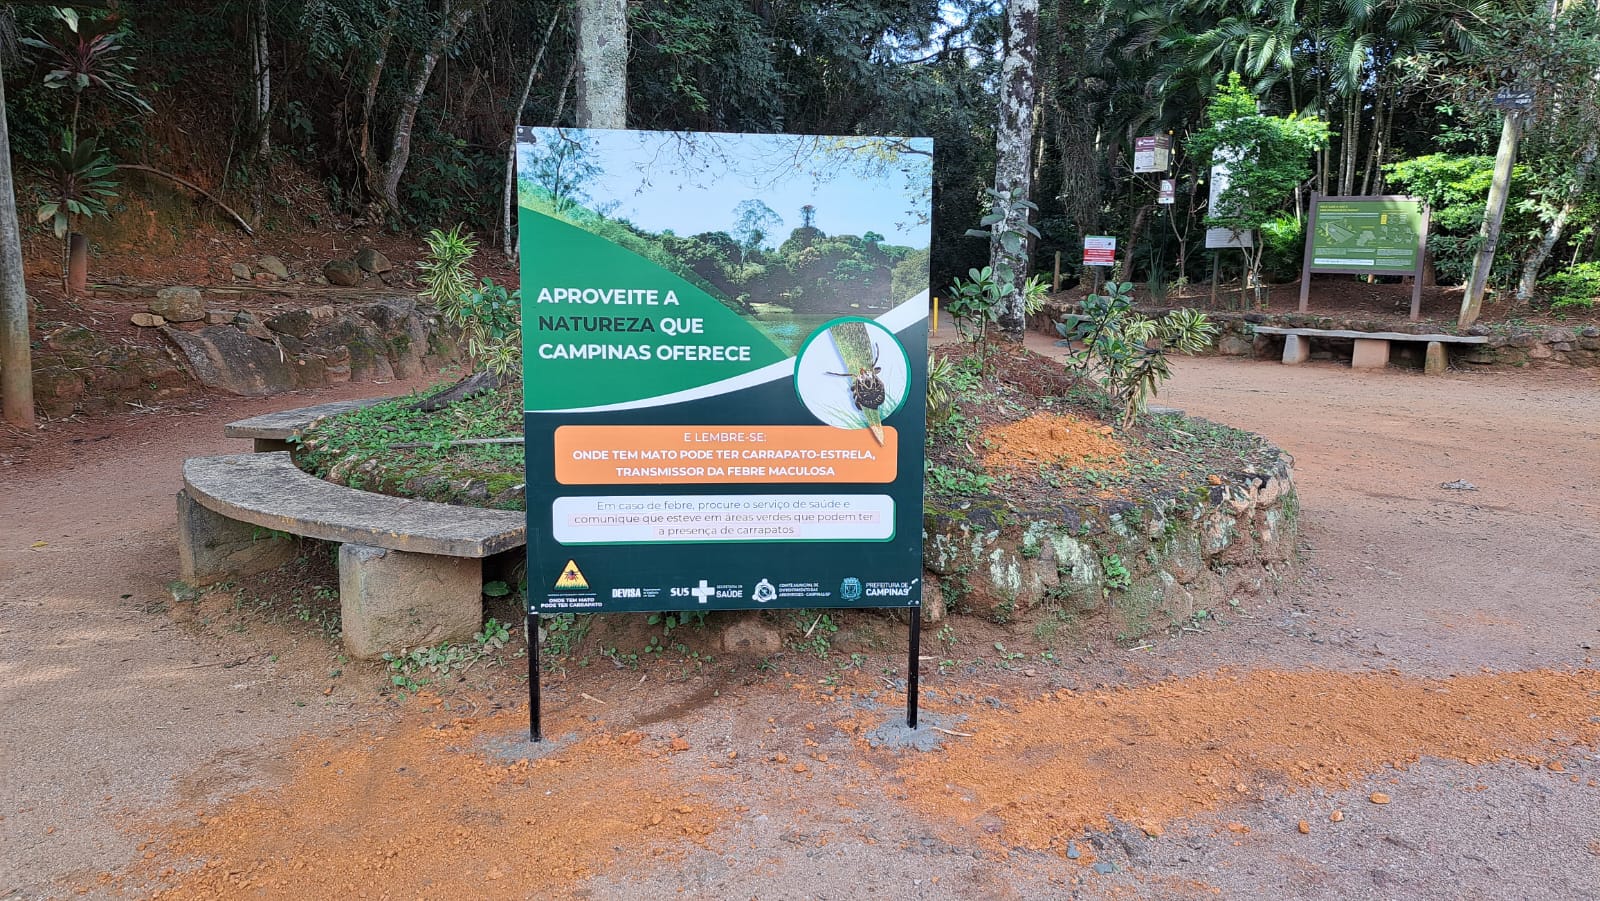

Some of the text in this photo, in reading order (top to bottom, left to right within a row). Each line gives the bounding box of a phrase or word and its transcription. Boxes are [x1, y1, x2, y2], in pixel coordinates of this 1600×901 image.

[537, 288, 680, 306] APROVEITE A
[538, 315, 704, 336] NATUREZA QUE
[538, 343, 751, 361] CAMPINAS OFERECE
[684, 432, 767, 442] E LEMBRE-SE:
[572, 450, 876, 461] ONDE TEM MATO PODE TER CARRAPATO-ESTRELA,
[616, 466, 836, 477] TRANSMISSOR DA FEBRE MACULOSA
[597, 501, 616, 511] Em
[618, 502, 644, 510] caso
[647, 501, 661, 510] de
[664, 500, 695, 511] febre,
[698, 501, 740, 513] procure
[753, 500, 790, 511] serviço
[793, 499, 806, 508] de
[809, 499, 841, 509] saúde
[574, 514, 640, 525] comunique
[642, 515, 664, 525] que
[666, 514, 702, 523] esteve
[725, 513, 754, 522] áreas
[756, 512, 792, 521] verdes
[794, 513, 815, 523] que
[817, 512, 856, 523] podem
[858, 512, 873, 521] ter
[658, 525, 794, 538] a presença de carrapatos
[612, 588, 641, 598] DEVISA
[670, 587, 689, 597] SUS
[716, 588, 743, 598] SAÚDE
[866, 588, 909, 597] CAMPINAS
